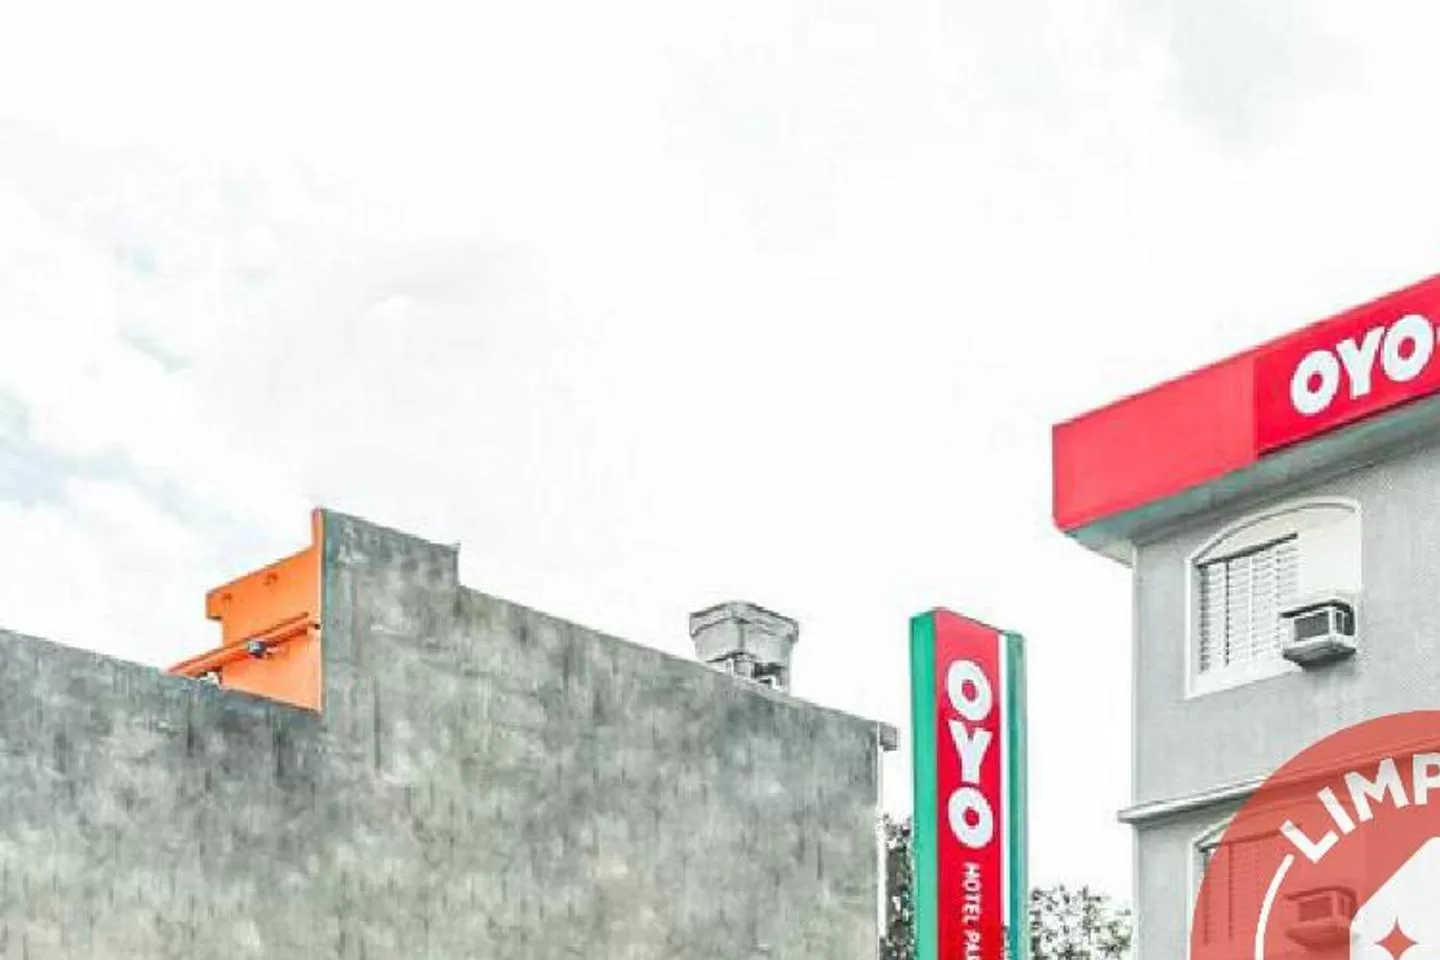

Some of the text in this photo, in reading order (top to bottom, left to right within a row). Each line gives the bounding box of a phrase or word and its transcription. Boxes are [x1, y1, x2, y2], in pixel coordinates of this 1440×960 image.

[1290, 314, 1435, 416] OYO
[946, 659, 993, 849] OYO
[961, 861, 983, 925] HOTEL
